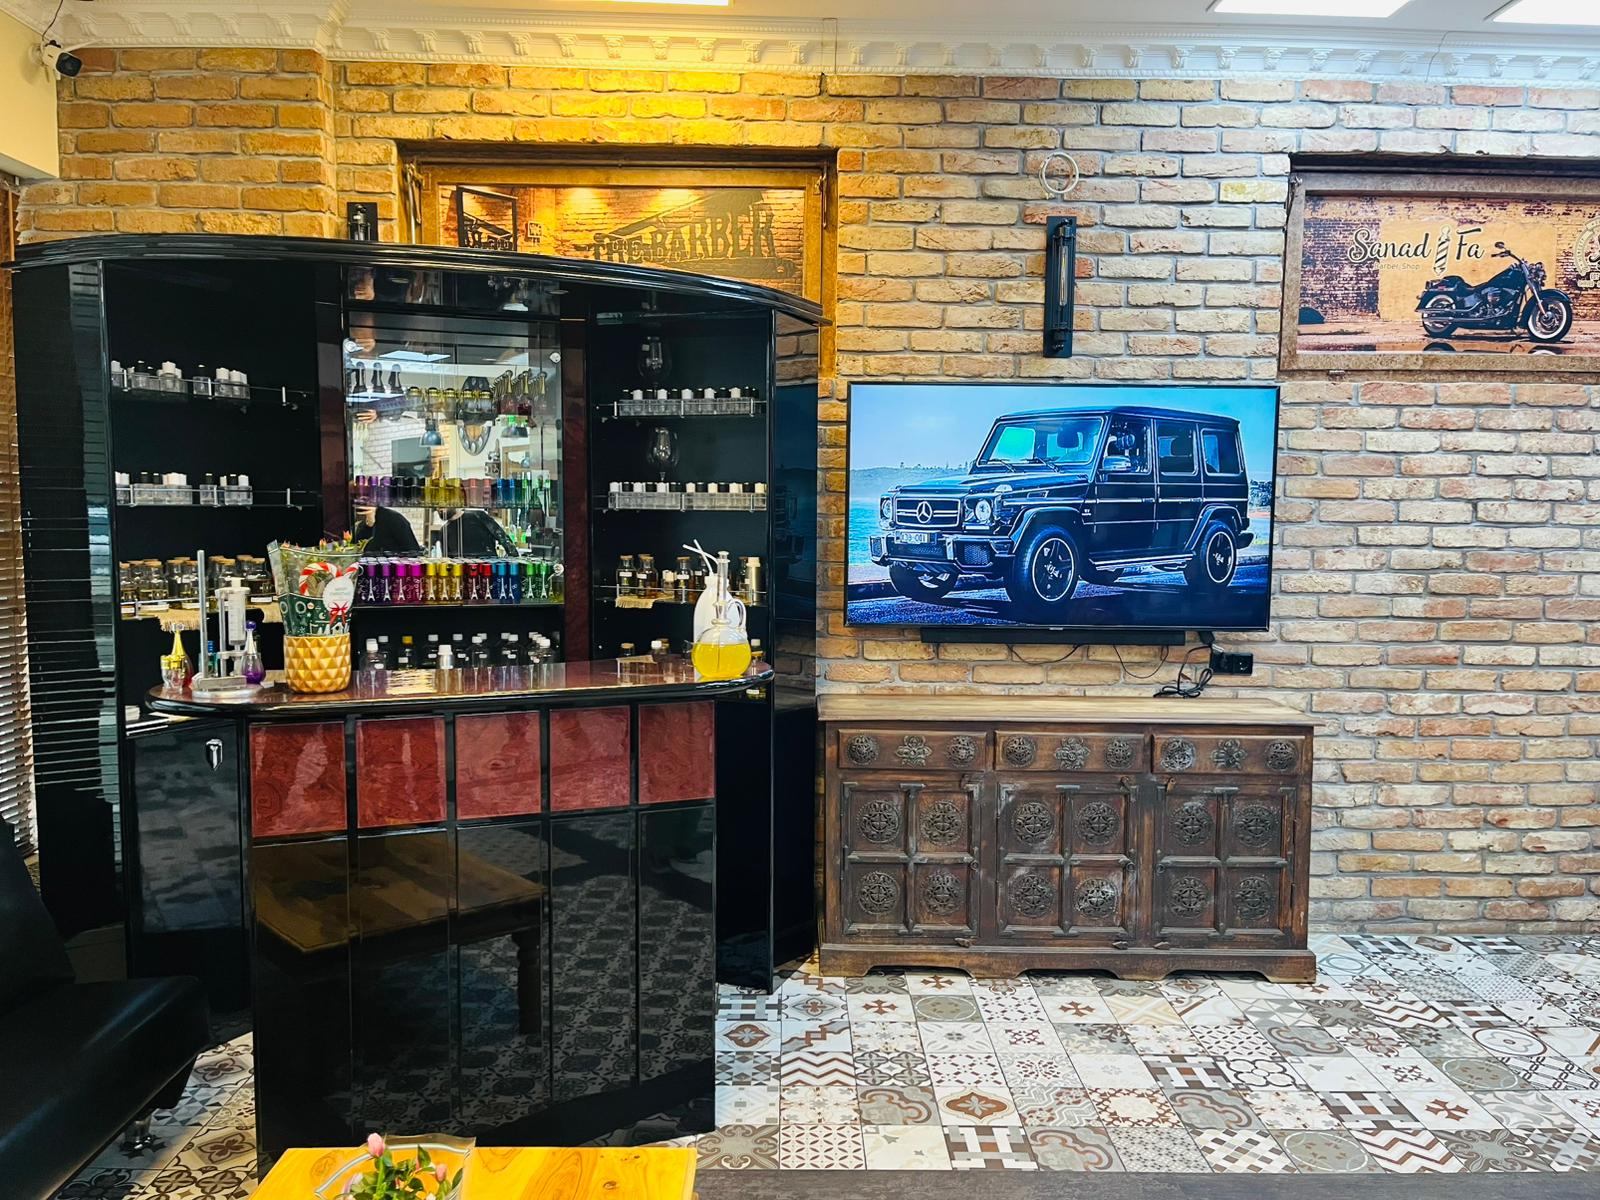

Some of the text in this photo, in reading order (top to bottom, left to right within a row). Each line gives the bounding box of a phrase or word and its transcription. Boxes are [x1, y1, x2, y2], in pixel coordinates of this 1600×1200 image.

[587, 202, 777, 264] THE BARBER
[1348, 227, 1485, 262] Sanad Fa
